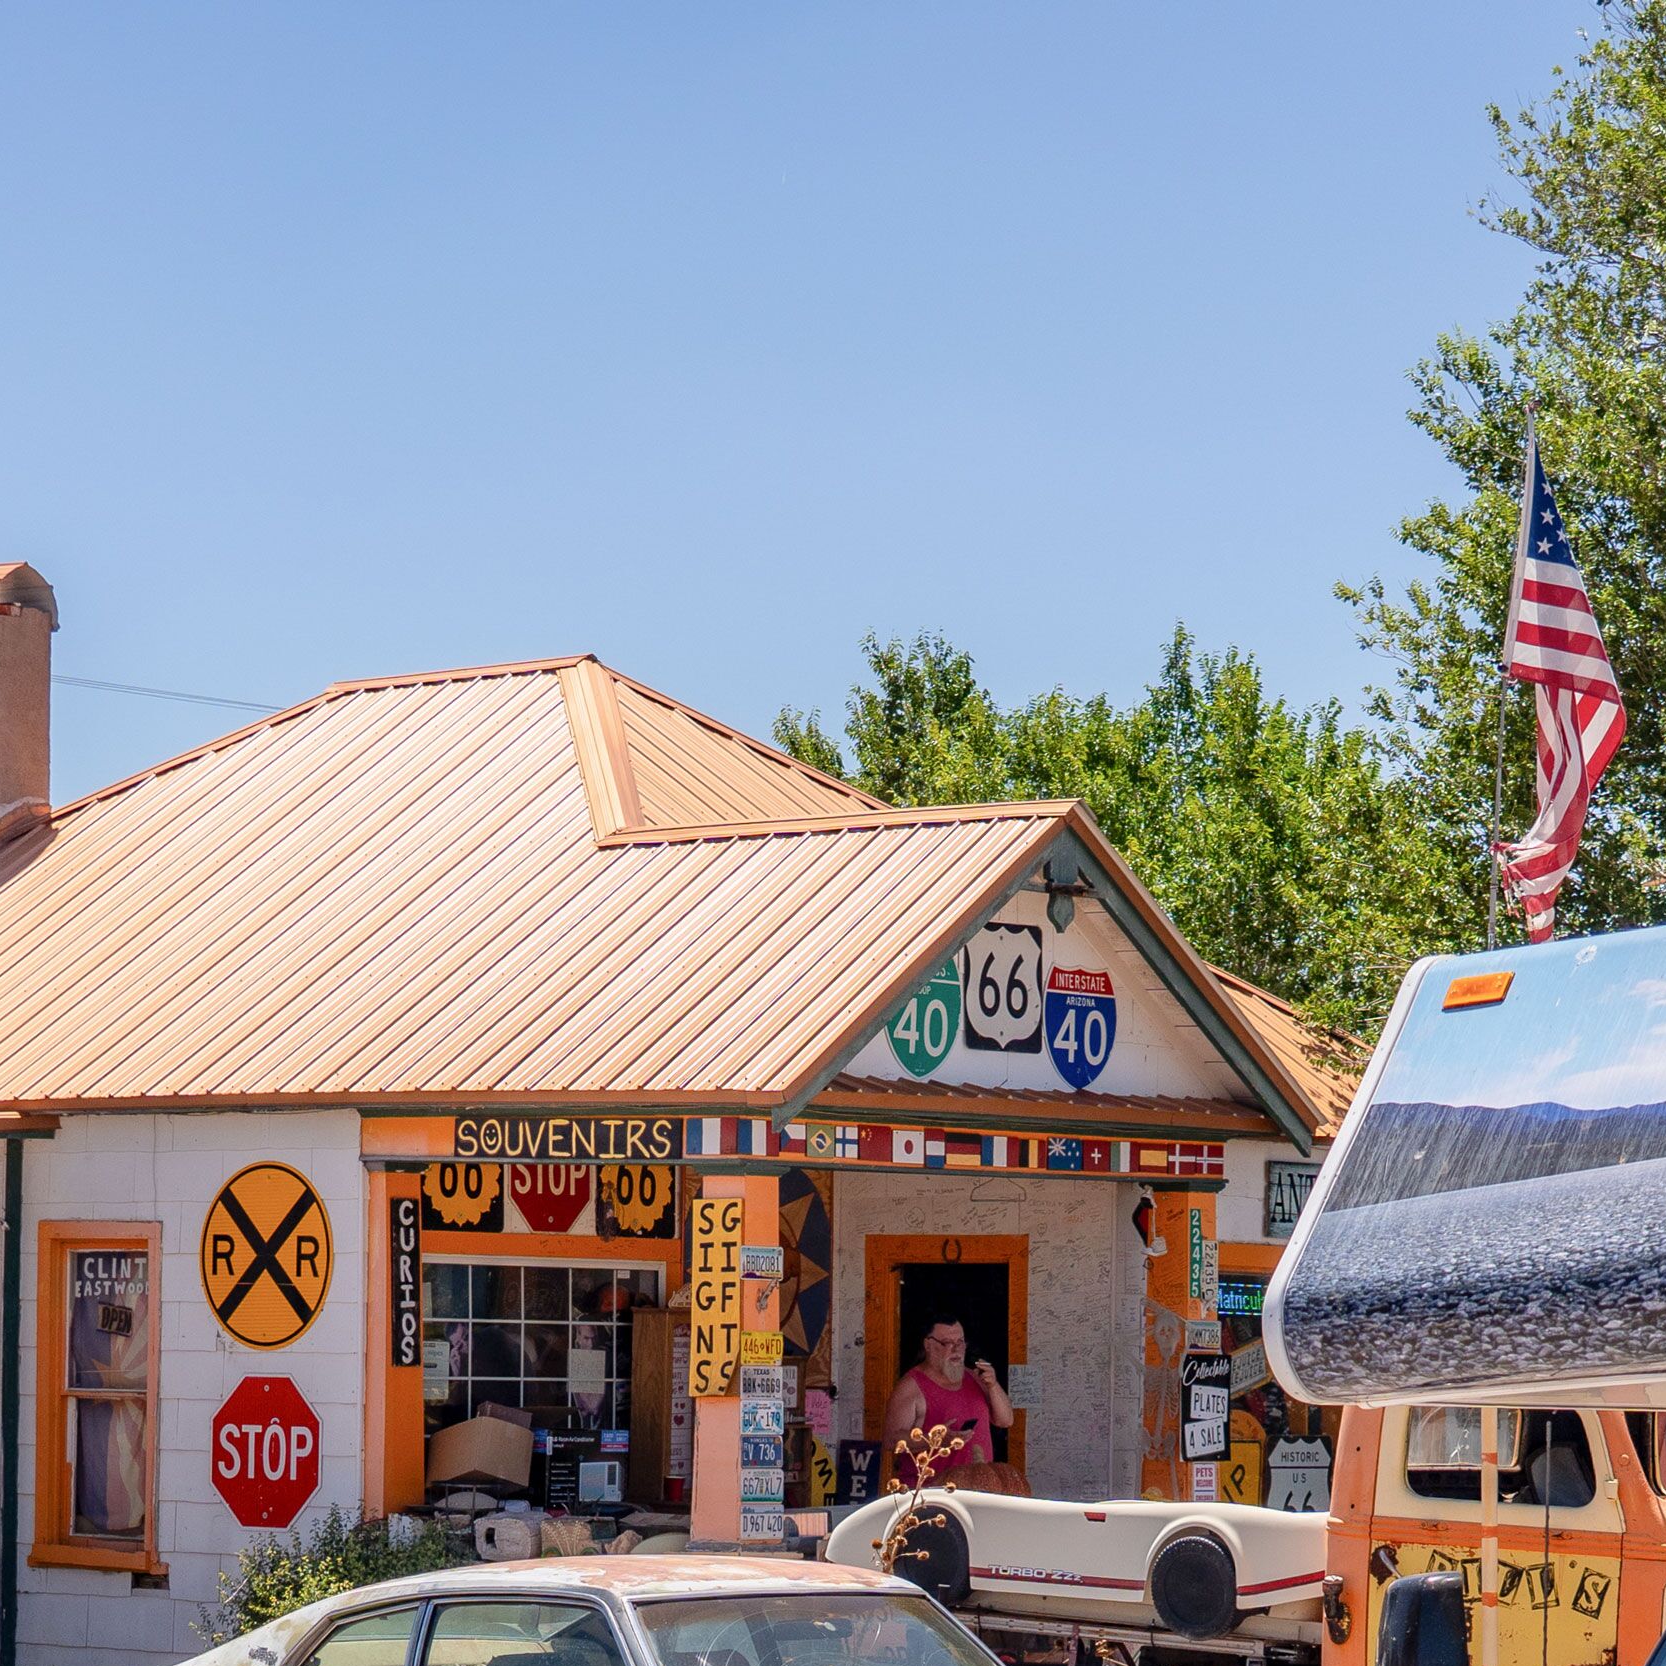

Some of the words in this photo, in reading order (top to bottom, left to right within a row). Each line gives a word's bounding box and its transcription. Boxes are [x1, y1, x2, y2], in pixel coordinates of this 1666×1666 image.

[979, 952, 1029, 1019] 66
[1055, 972, 1106, 992] INTERSTATE
[1066, 996, 1096, 1008] ARIZONA
[893, 998, 948, 1057] 40
[1054, 1009, 1107, 1066] 40
[456, 1119, 672, 1158] SOUVENIRS
[514, 1164, 588, 1196] STOP
[1191, 1209, 1201, 1297] 22435
[84, 1257, 148, 1279] CLINT
[398, 1200, 417, 1364] CURIOS
[695, 1202, 715, 1393] SIGNS
[718, 1201, 741, 1393] GIFTS
[101, 1306, 132, 1334] OPEN
[753, 1368, 770, 1376] TEXAS
[1193, 1392, 1226, 1415] PLATES
[1189, 1430, 1195, 1449] 4
[1201, 1425, 1223, 1448] SALE
[218, 1423, 314, 1482] STOP
[1280, 1450, 1320, 1463] HISTORIC
[1195, 1467, 1214, 1478] PETS
[1292, 1472, 1307, 1484] US
[988, 1564, 1046, 1579] TURBO
